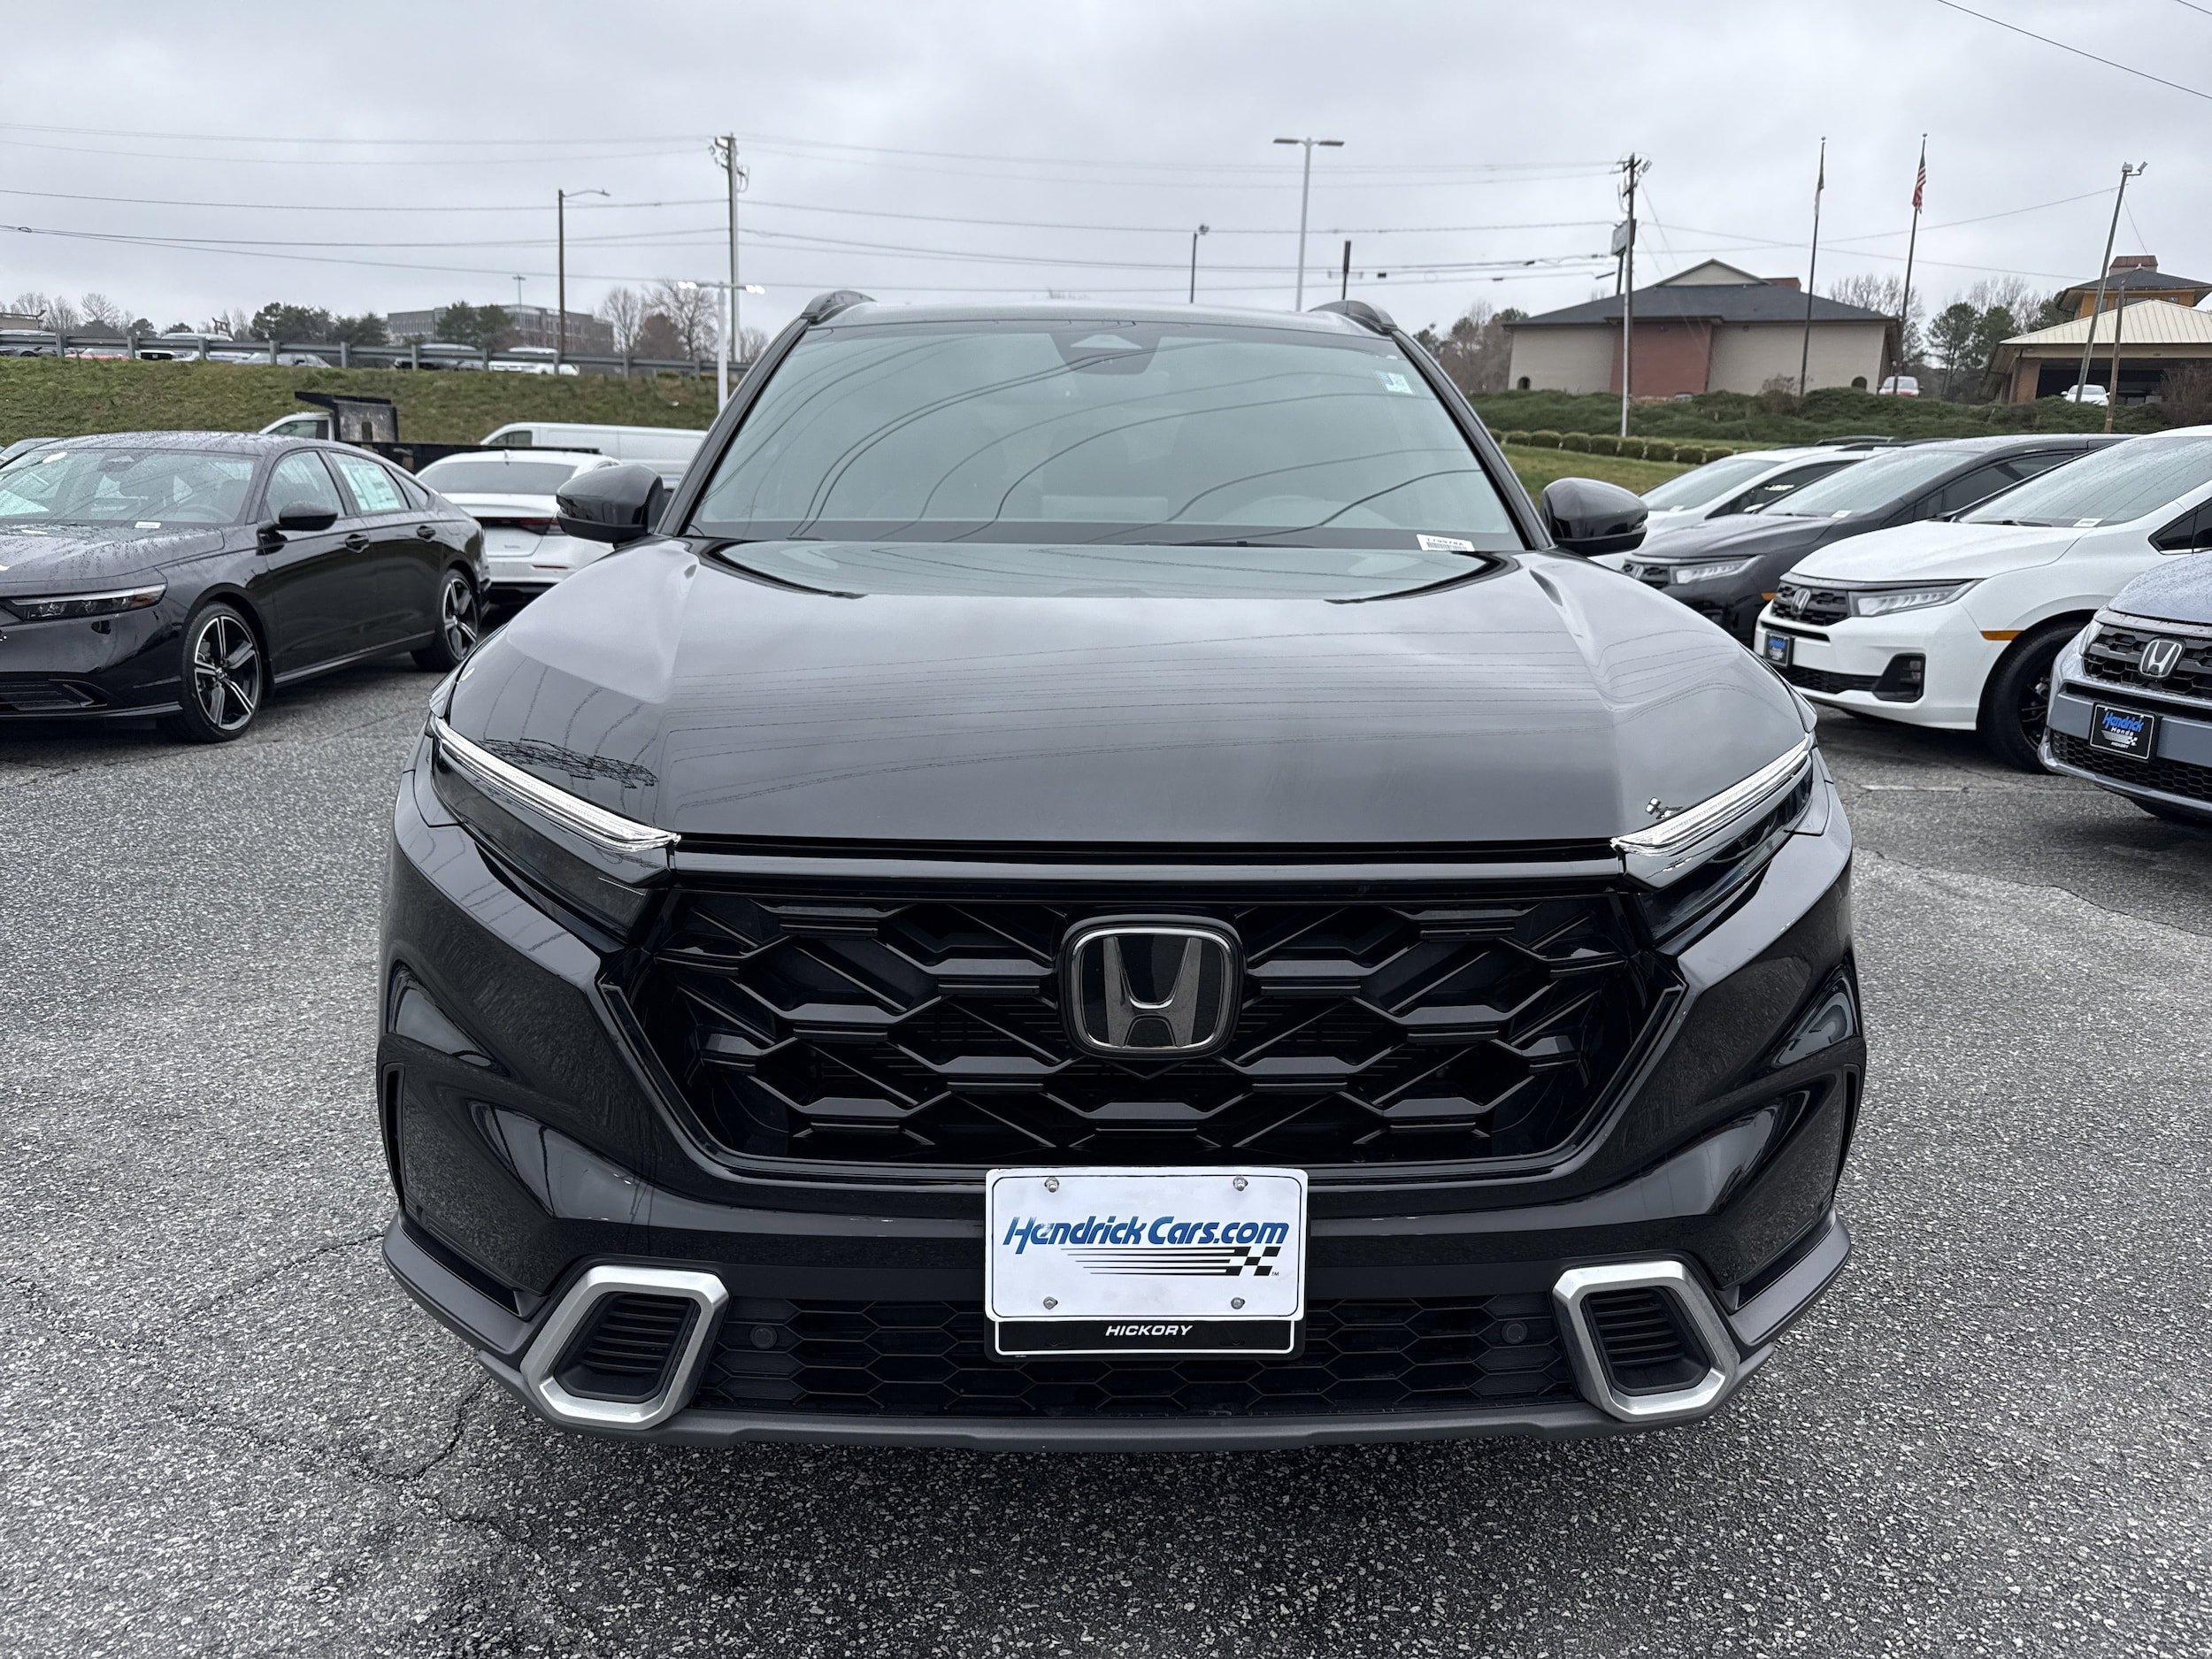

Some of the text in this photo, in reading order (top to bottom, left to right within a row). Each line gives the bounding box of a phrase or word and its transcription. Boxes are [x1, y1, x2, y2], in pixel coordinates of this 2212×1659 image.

[2102, 711, 2144, 733] Hendrick
[2111, 726, 2134, 736] Honda
[1105, 1325, 1194, 1337] HICKORY
